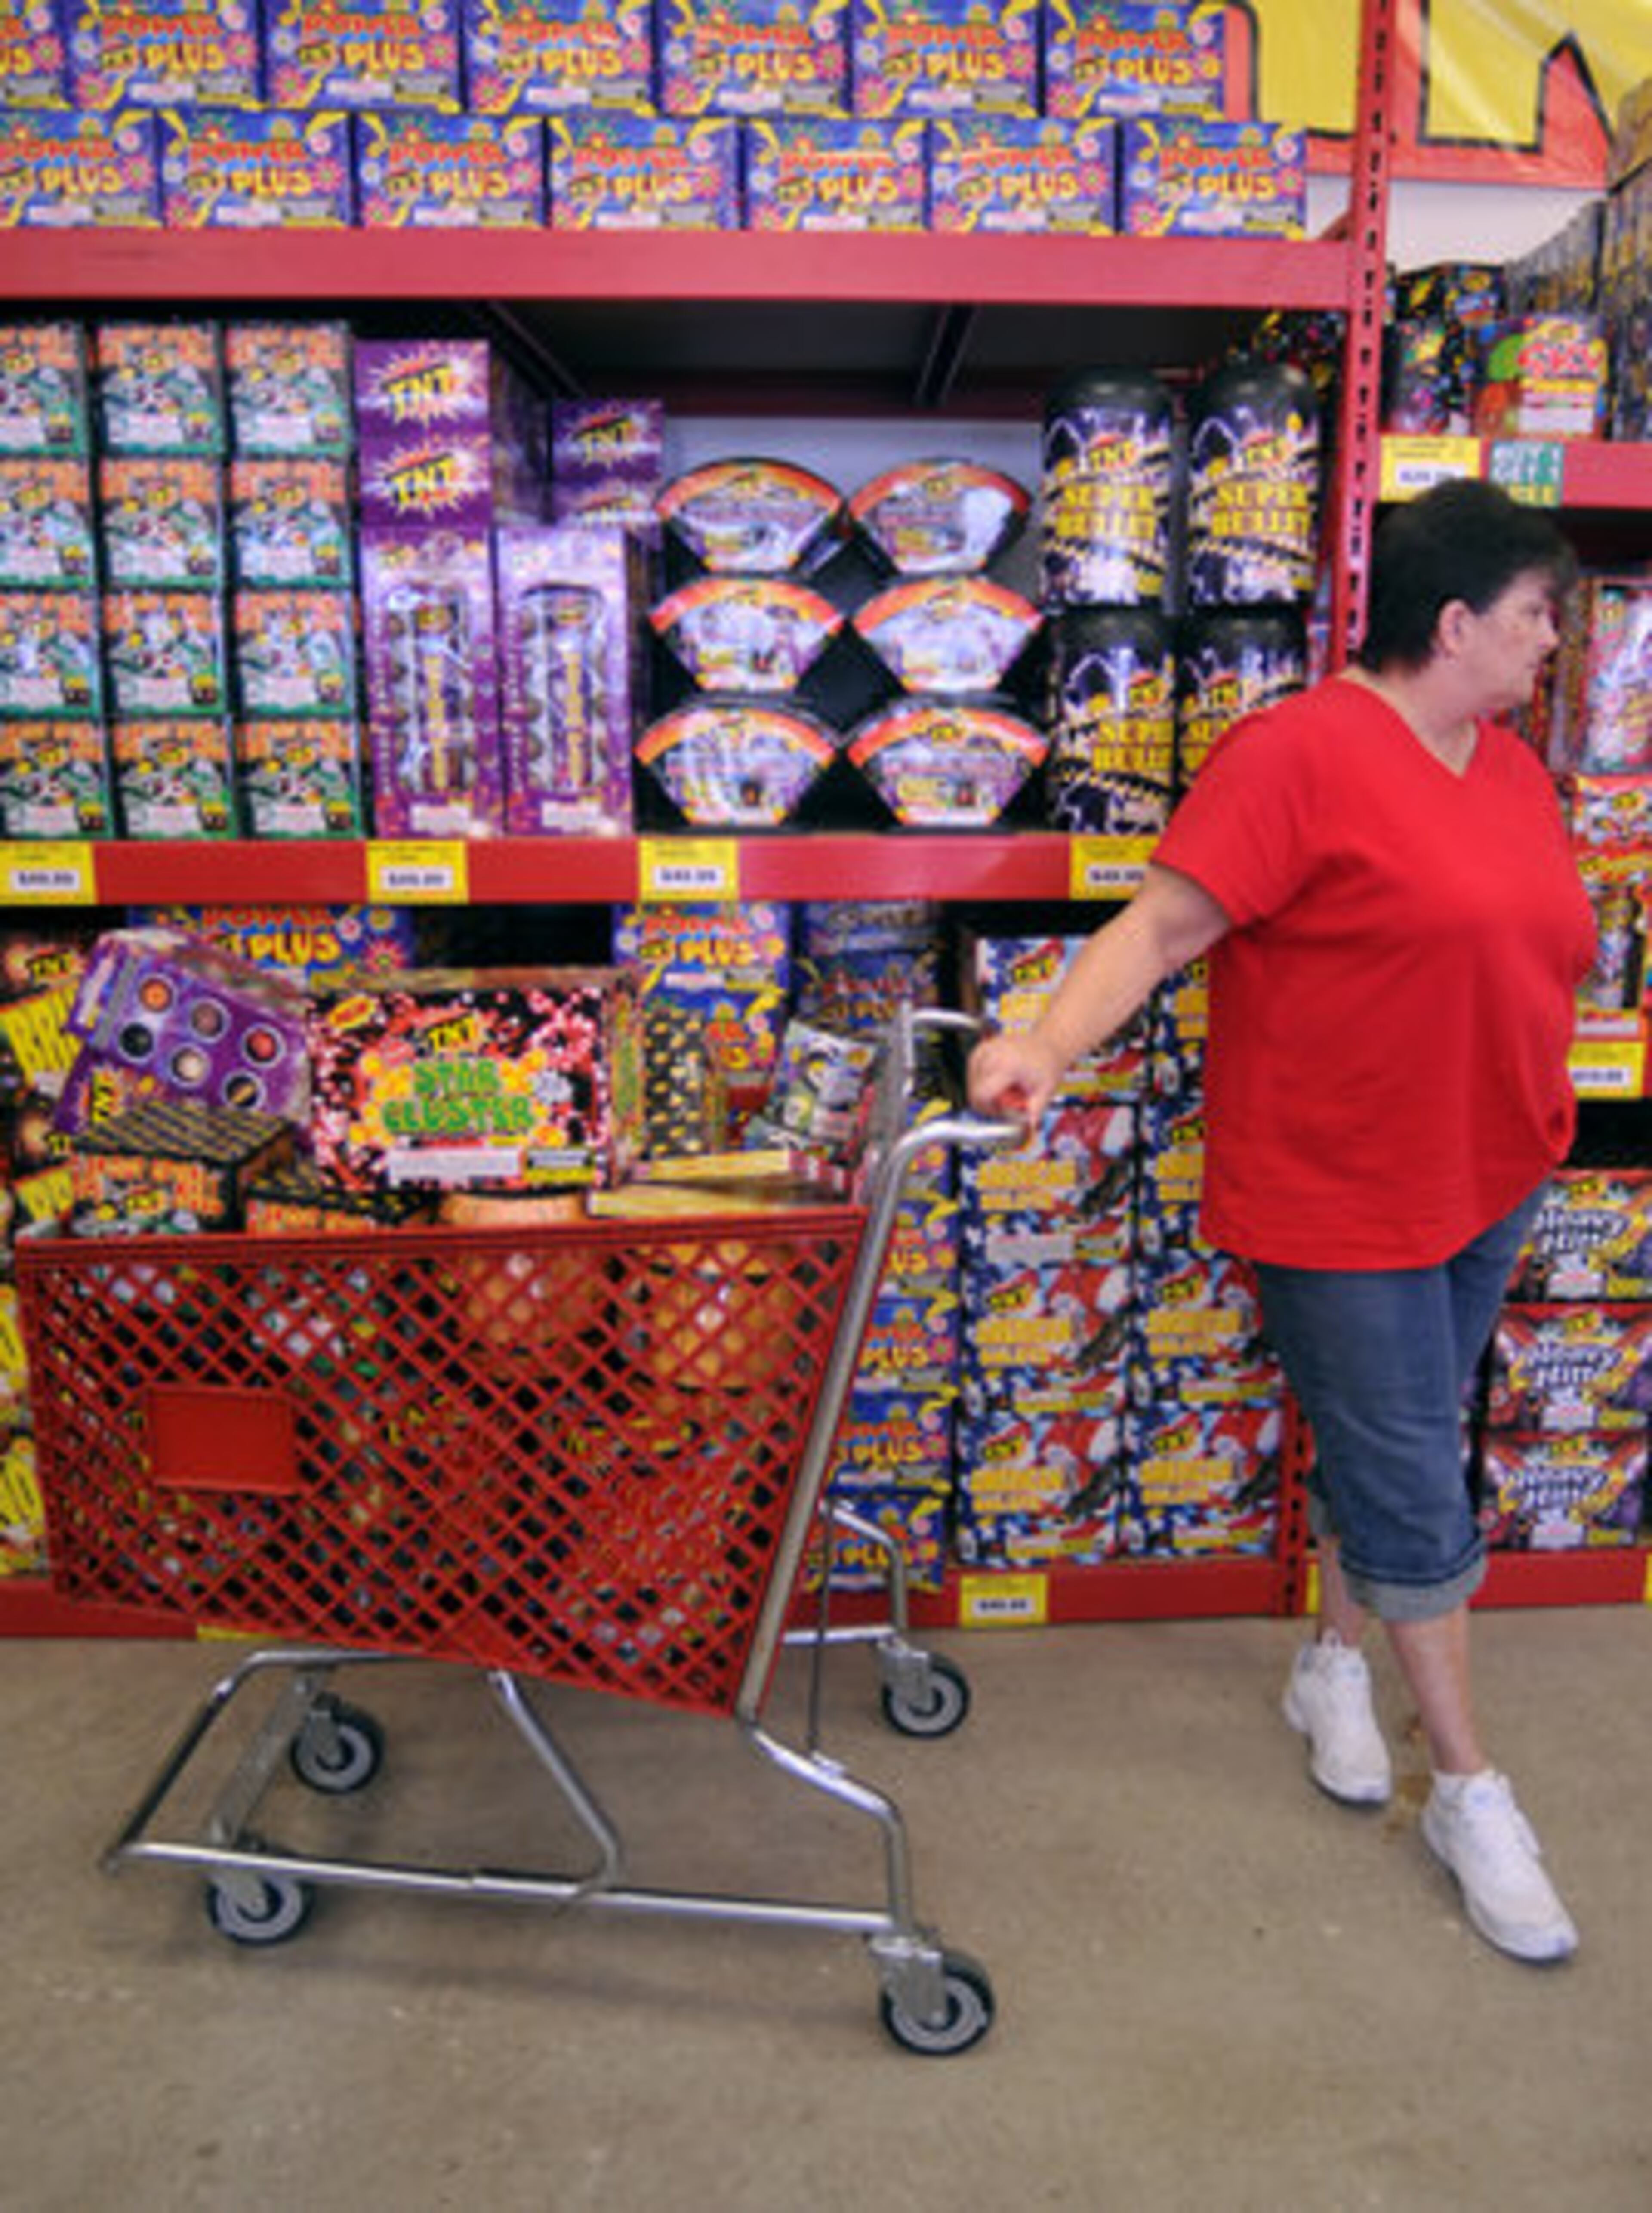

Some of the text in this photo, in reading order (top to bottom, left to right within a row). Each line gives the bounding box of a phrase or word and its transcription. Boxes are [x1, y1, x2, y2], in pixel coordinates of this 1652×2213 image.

[145, 42, 225, 72] PLUS
[344, 42, 425, 71] PLUS
[542, 48, 623, 76] PLUS
[735, 52, 815, 80] PLUS
[925, 51, 1005, 81] PLUS
[1114, 56, 1193, 84] PLUS
[40, 166, 123, 194] PLUS
[231, 167, 312, 195] PLUS
[432, 169, 509, 198] PLUS
[614, 172, 692, 200] PLUS
[819, 175, 898, 202] PLUS
[1001, 174, 1079, 202] PLUS
[1199, 174, 1276, 202] PLUS
[388, 366, 453, 421] TNT
[388, 456, 454, 508] TNT
[248, 932, 342, 965] PLUS
[680, 938, 754, 965] PLUS
[430, 1017, 477, 1052] TNT
[414, 1059, 499, 1094] STAR
[383, 1096, 534, 1133] CLUSTER
